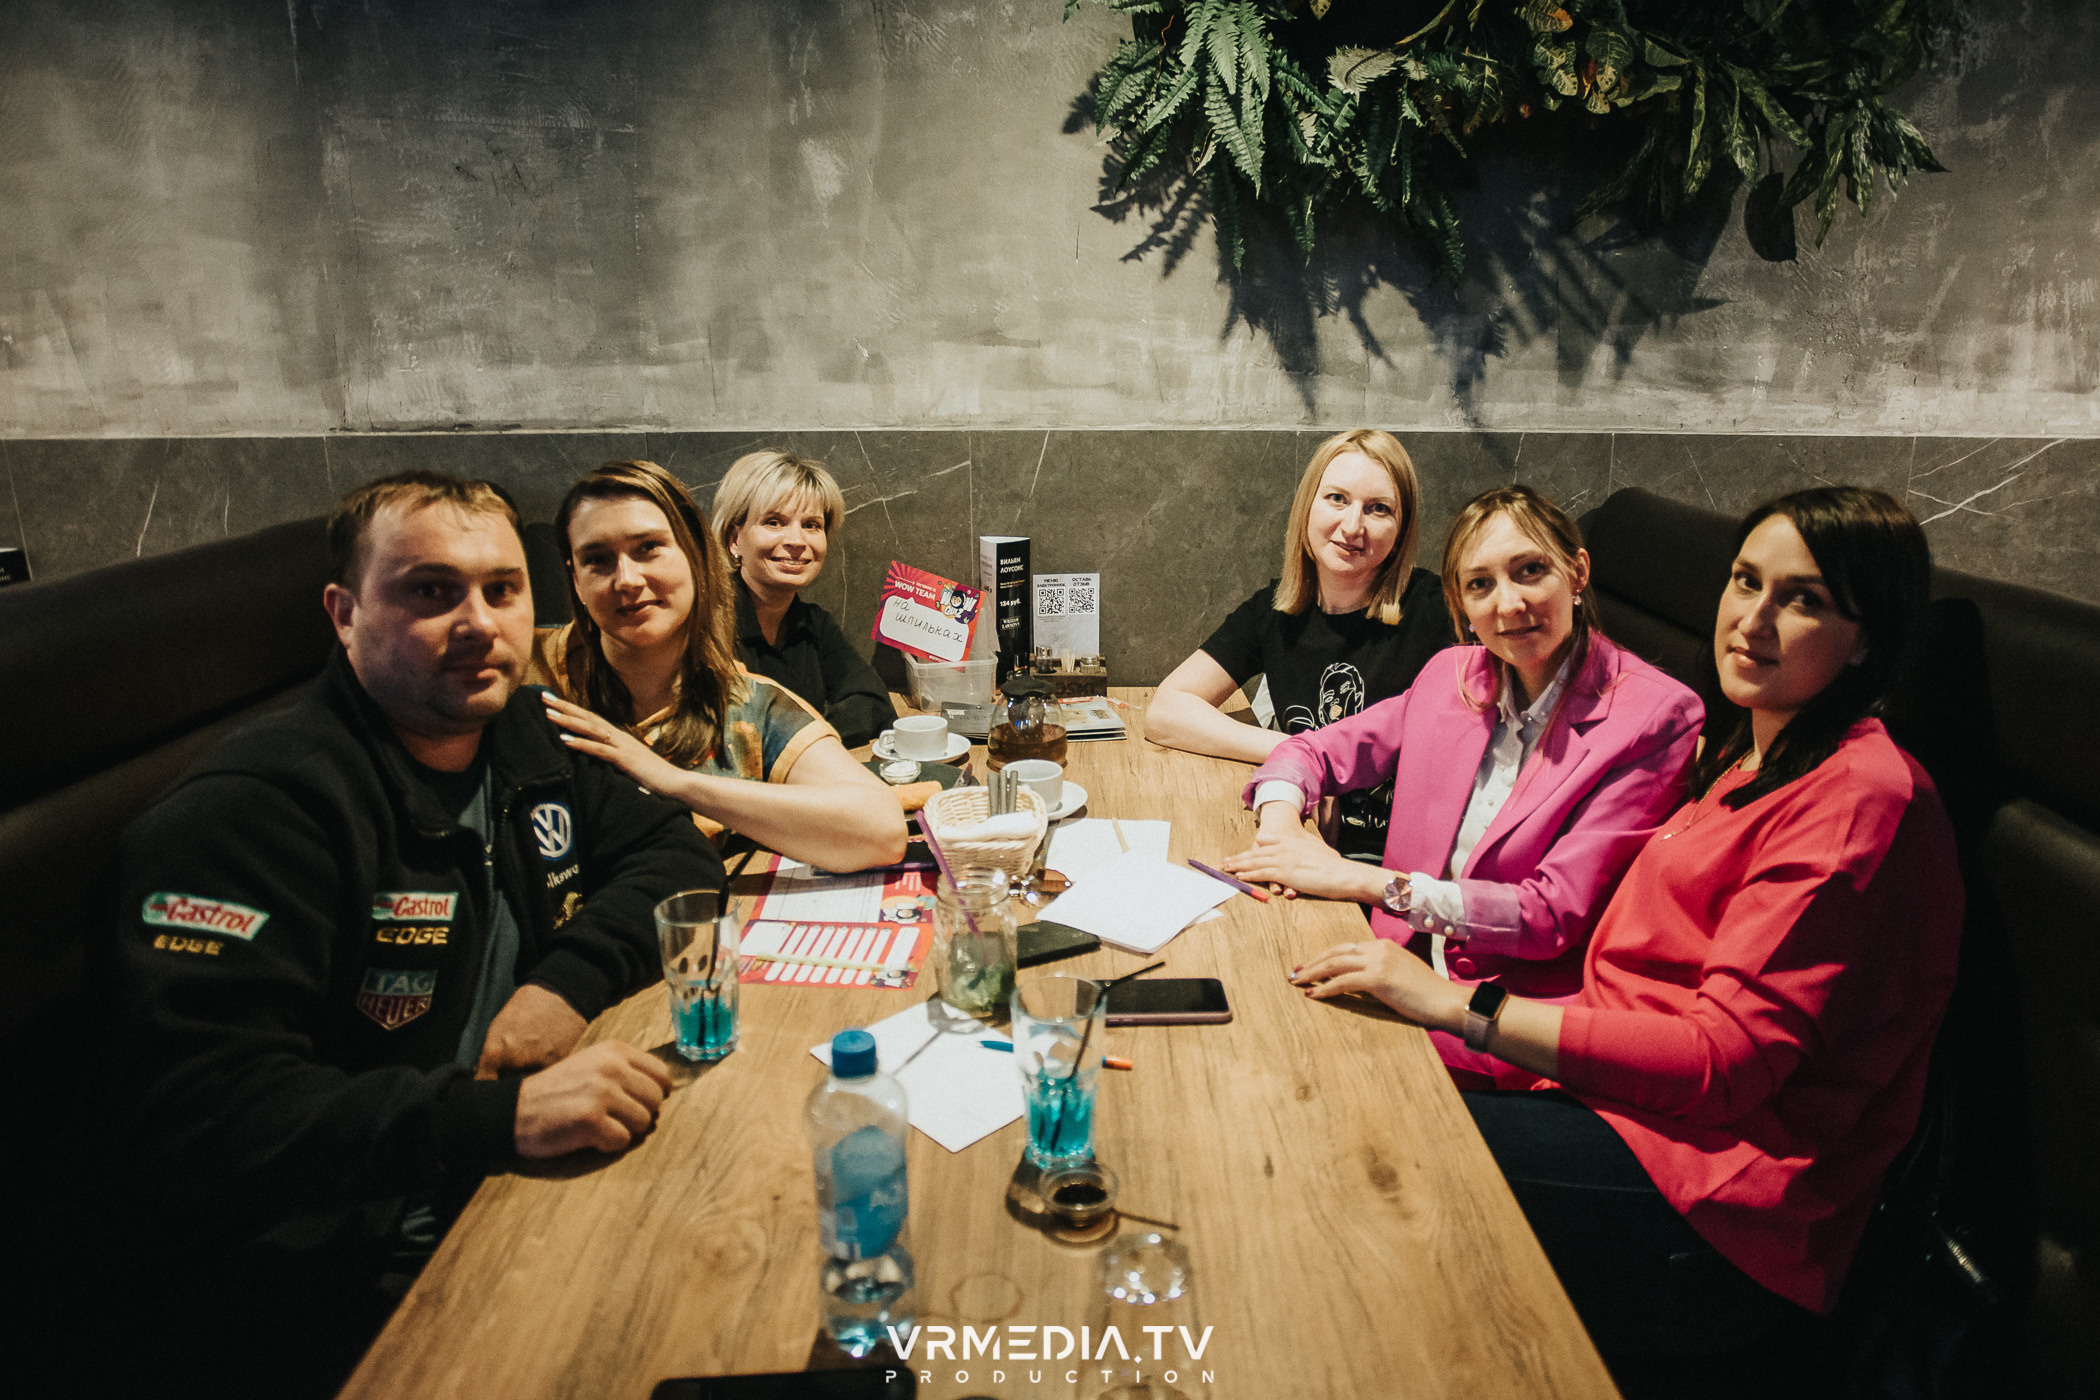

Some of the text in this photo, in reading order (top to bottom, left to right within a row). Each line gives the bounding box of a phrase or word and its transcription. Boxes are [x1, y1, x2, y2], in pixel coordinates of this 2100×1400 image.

[894, 580, 936, 601] WOW TEAM
[893, 598, 910, 612] на
[944, 605, 964, 619] QUIZ
[895, 612, 963, 643] шпильках
[166, 897, 256, 934] Castrol
[393, 896, 450, 917] Castrol
[153, 934, 224, 956] EDGE
[376, 926, 450, 945] EDGE
[373, 973, 432, 994] TAG
